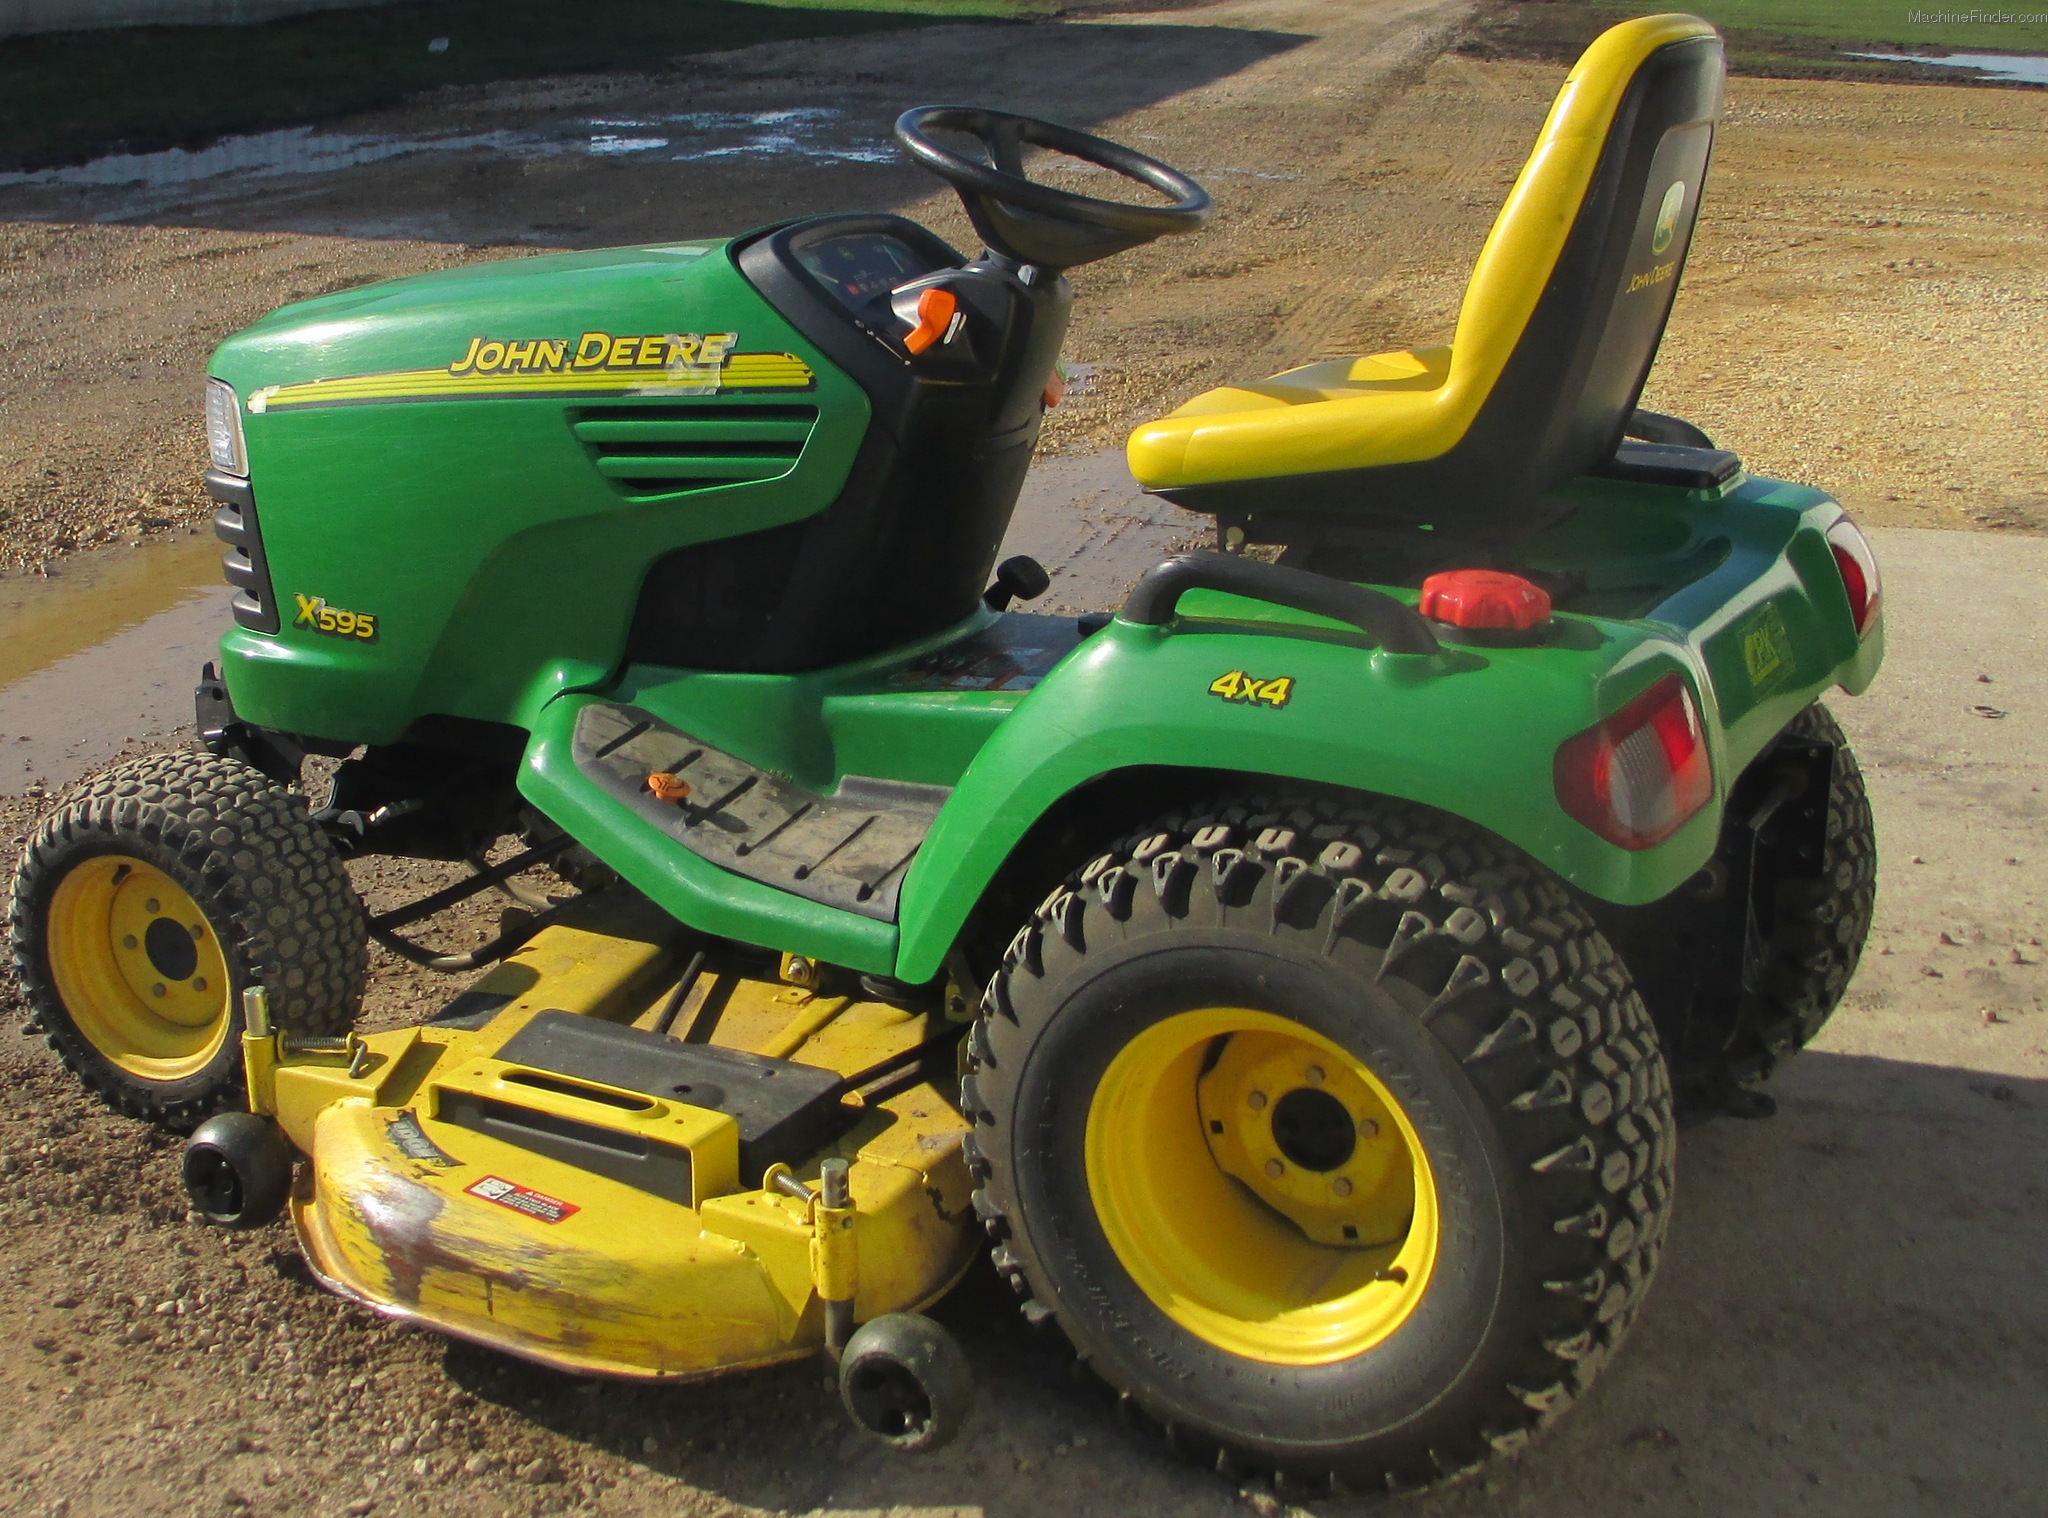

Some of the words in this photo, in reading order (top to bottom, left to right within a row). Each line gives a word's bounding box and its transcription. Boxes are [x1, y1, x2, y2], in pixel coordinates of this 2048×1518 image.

[1625, 272, 1651, 294] JOHN
[1649, 260, 1675, 285] DEERE
[448, 336, 570, 375] JOHN
[571, 331, 736, 371] DEERE
[293, 592, 376, 641] X595
[533, 1192, 564, 1207] DANGER
